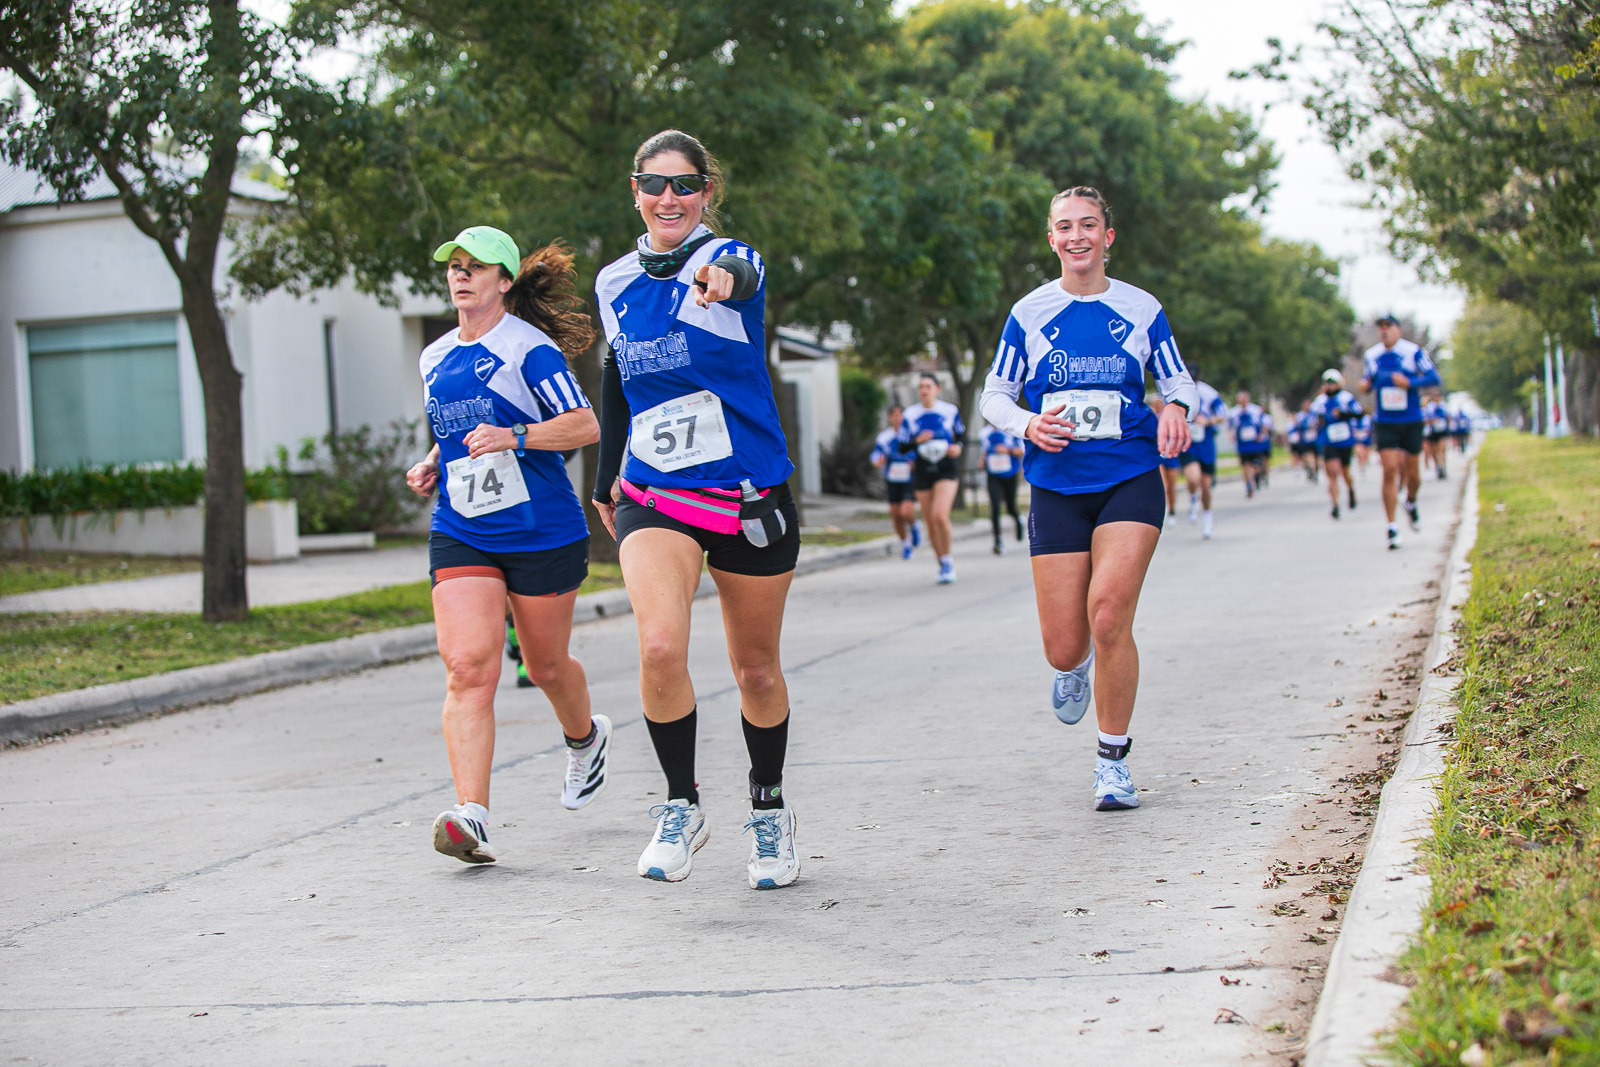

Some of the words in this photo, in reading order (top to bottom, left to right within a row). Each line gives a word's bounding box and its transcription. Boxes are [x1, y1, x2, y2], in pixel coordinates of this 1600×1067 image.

[1048, 349, 1068, 387] 3
[1069, 354, 1127, 373] MARATÓN
[427, 397, 449, 439] 3
[440, 396, 495, 422] MARATÓN
[653, 415, 697, 455] 57
[462, 467, 504, 503] 74
